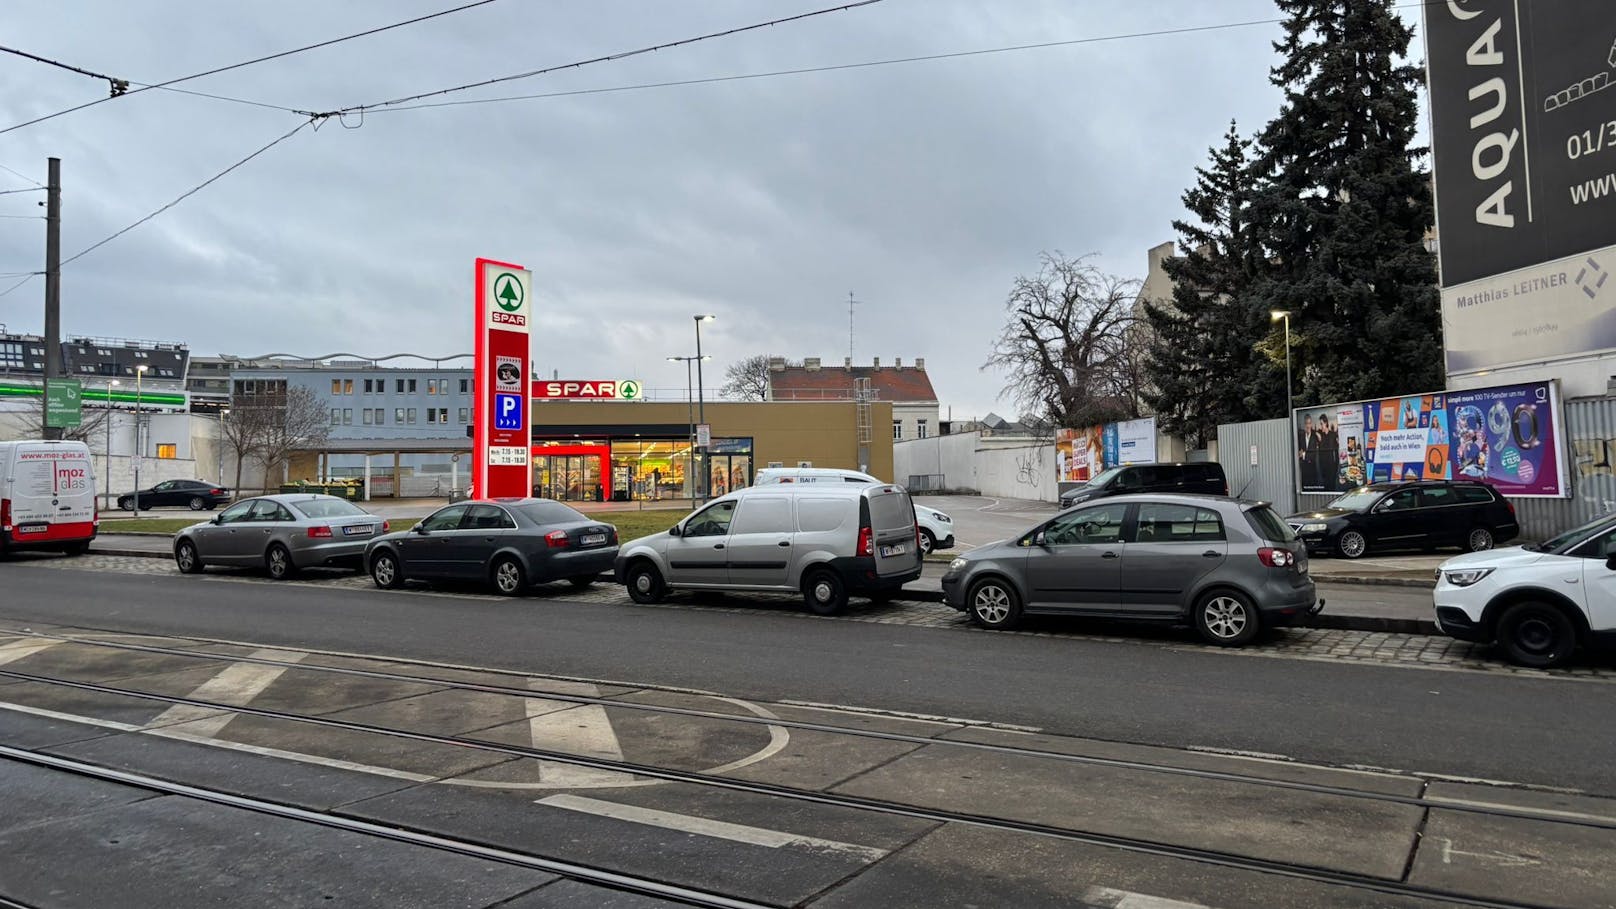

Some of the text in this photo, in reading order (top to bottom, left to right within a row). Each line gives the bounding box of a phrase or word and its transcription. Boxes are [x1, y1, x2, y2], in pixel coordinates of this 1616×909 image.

[1457, 288, 1509, 309] Matthias
[493, 313, 525, 326] SPAR
[546, 382, 615, 396] SPAR
[503, 396, 516, 417] P
[59, 468, 85, 478] moz
